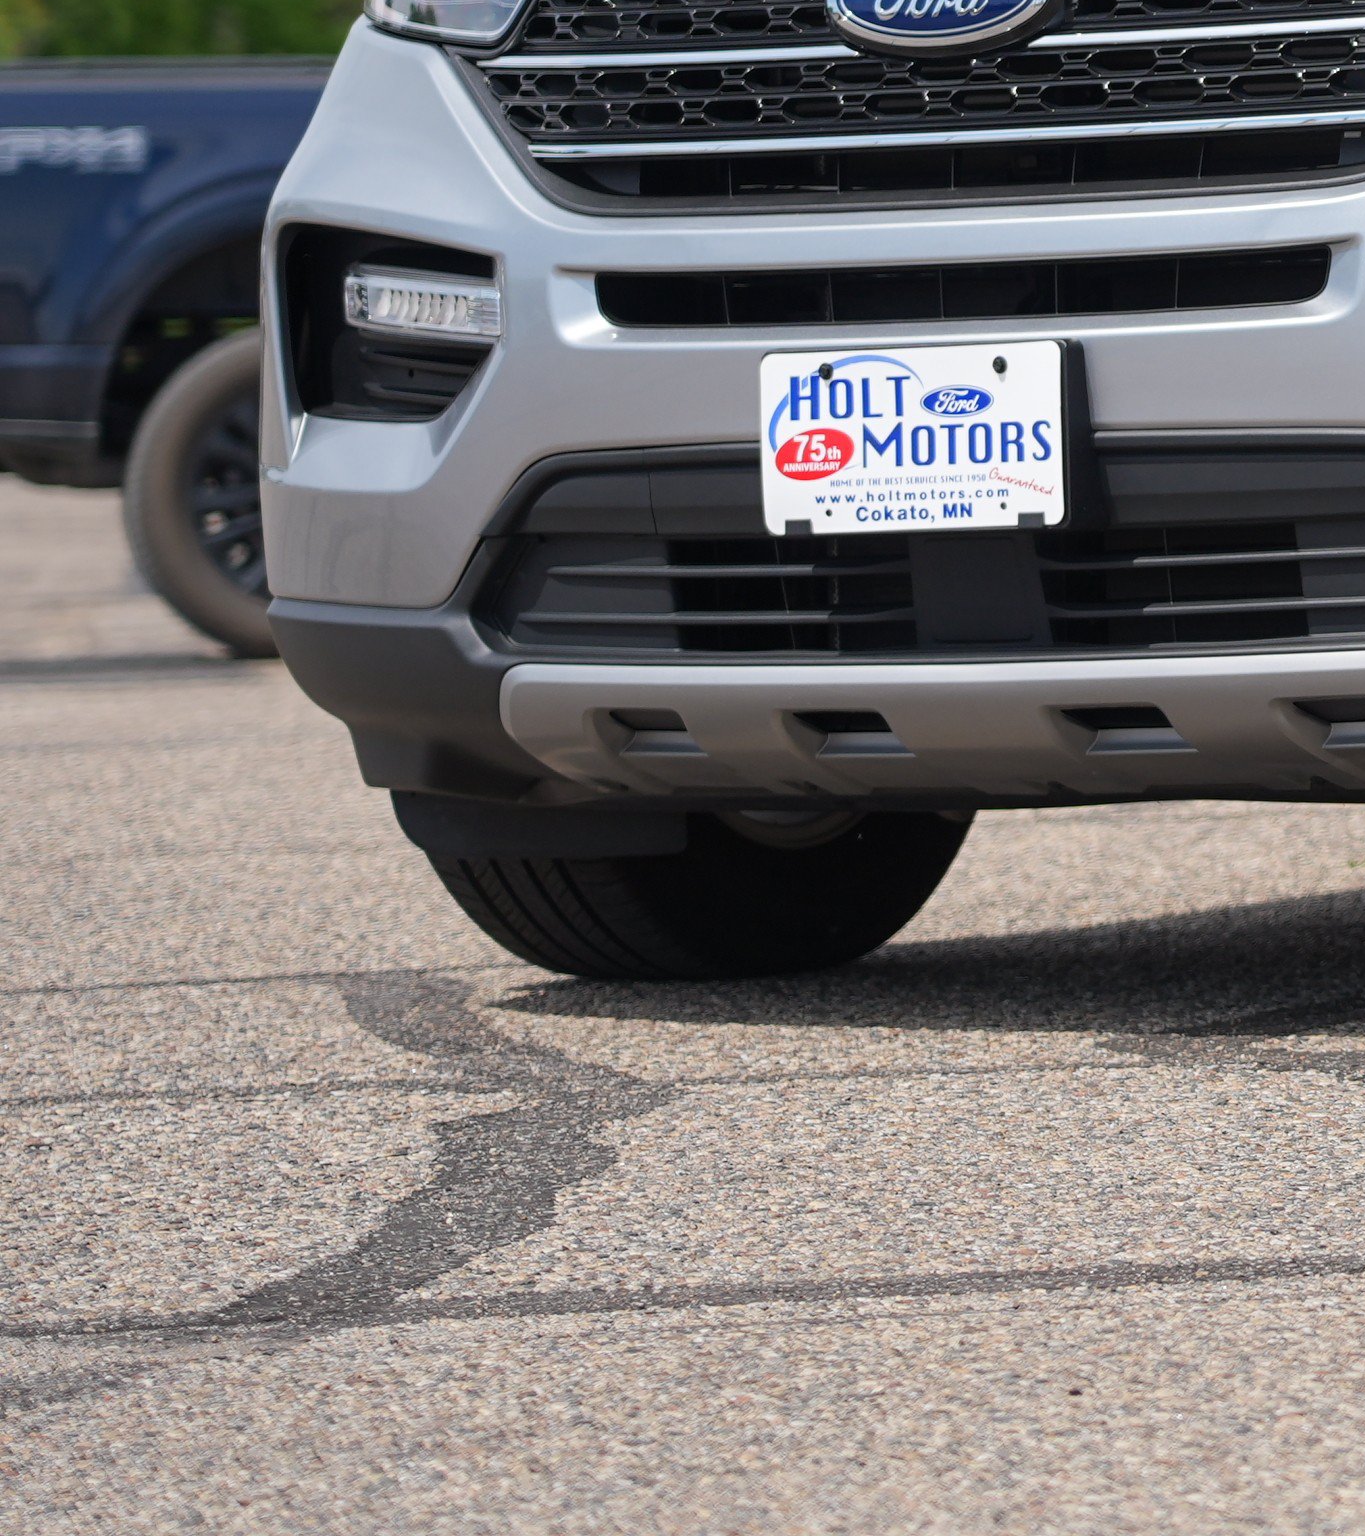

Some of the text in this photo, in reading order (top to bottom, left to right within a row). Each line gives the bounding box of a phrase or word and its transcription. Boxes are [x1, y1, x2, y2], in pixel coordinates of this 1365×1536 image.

[790, 375, 911, 421] HOLT
[935, 390, 980, 413] Ford
[793, 434, 841, 462] 75th
[863, 420, 1052, 468] MOTORS
[783, 462, 841, 473] ANNIVERSARY
[830, 479, 852, 487] HOME
[868, 478, 881, 486] THE
[885, 477, 903, 485] BEST
[906, 476, 937, 484] SERVICE
[941, 475, 963, 483] SINCE
[968, 474, 986, 482] 1950
[989, 467, 1055, 496] Guaranteed
[815, 488, 1009, 504] www.holtmotors.com
[856, 503, 973, 522] Cokato, MN
